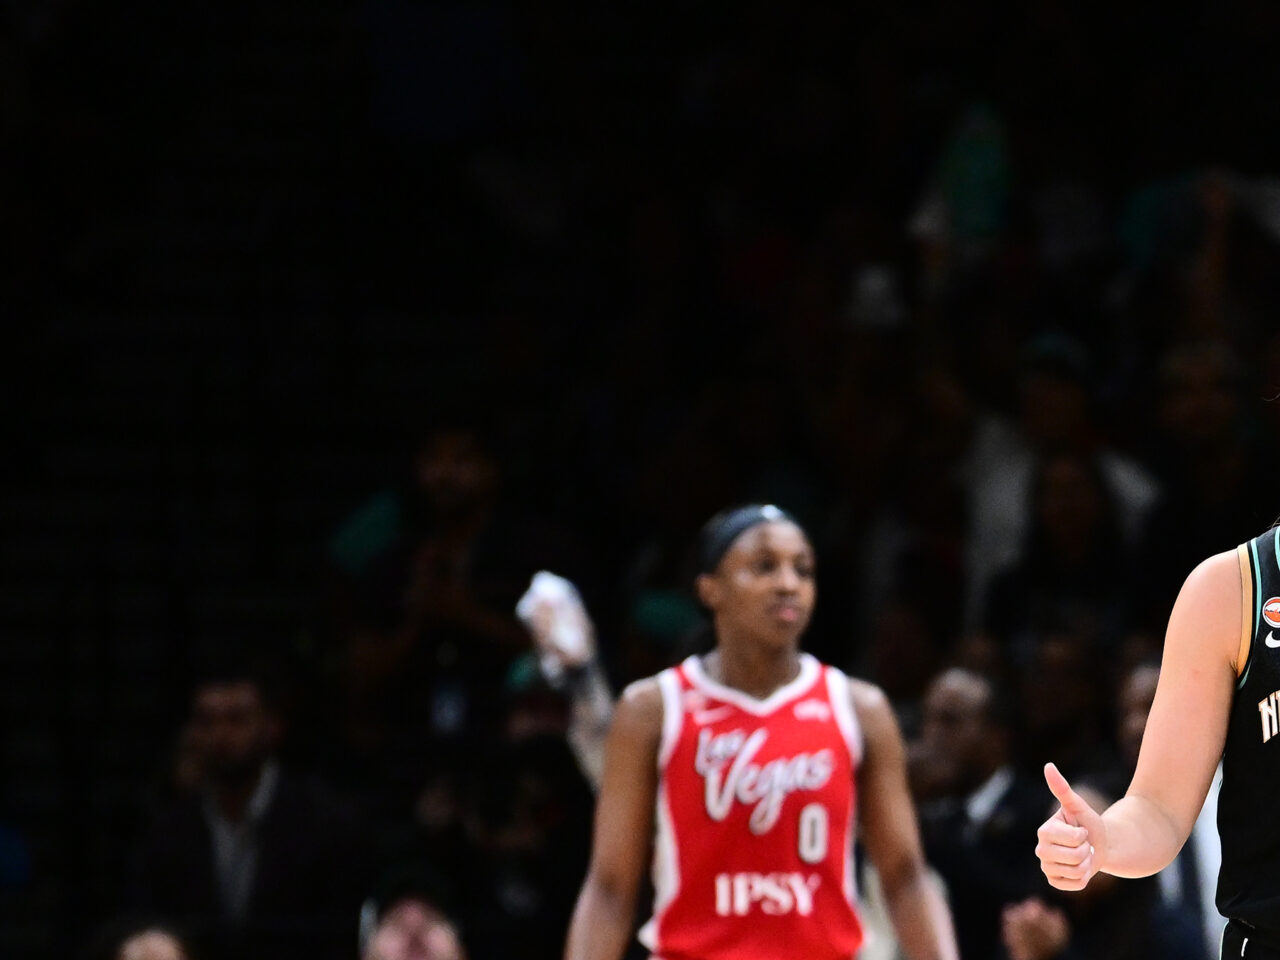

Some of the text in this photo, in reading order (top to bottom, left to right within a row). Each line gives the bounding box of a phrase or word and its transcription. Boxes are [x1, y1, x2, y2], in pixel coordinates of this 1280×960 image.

[705, 727, 834, 835] Vegas
[799, 803, 829, 864] 0
[715, 872, 822, 917] IPSY
